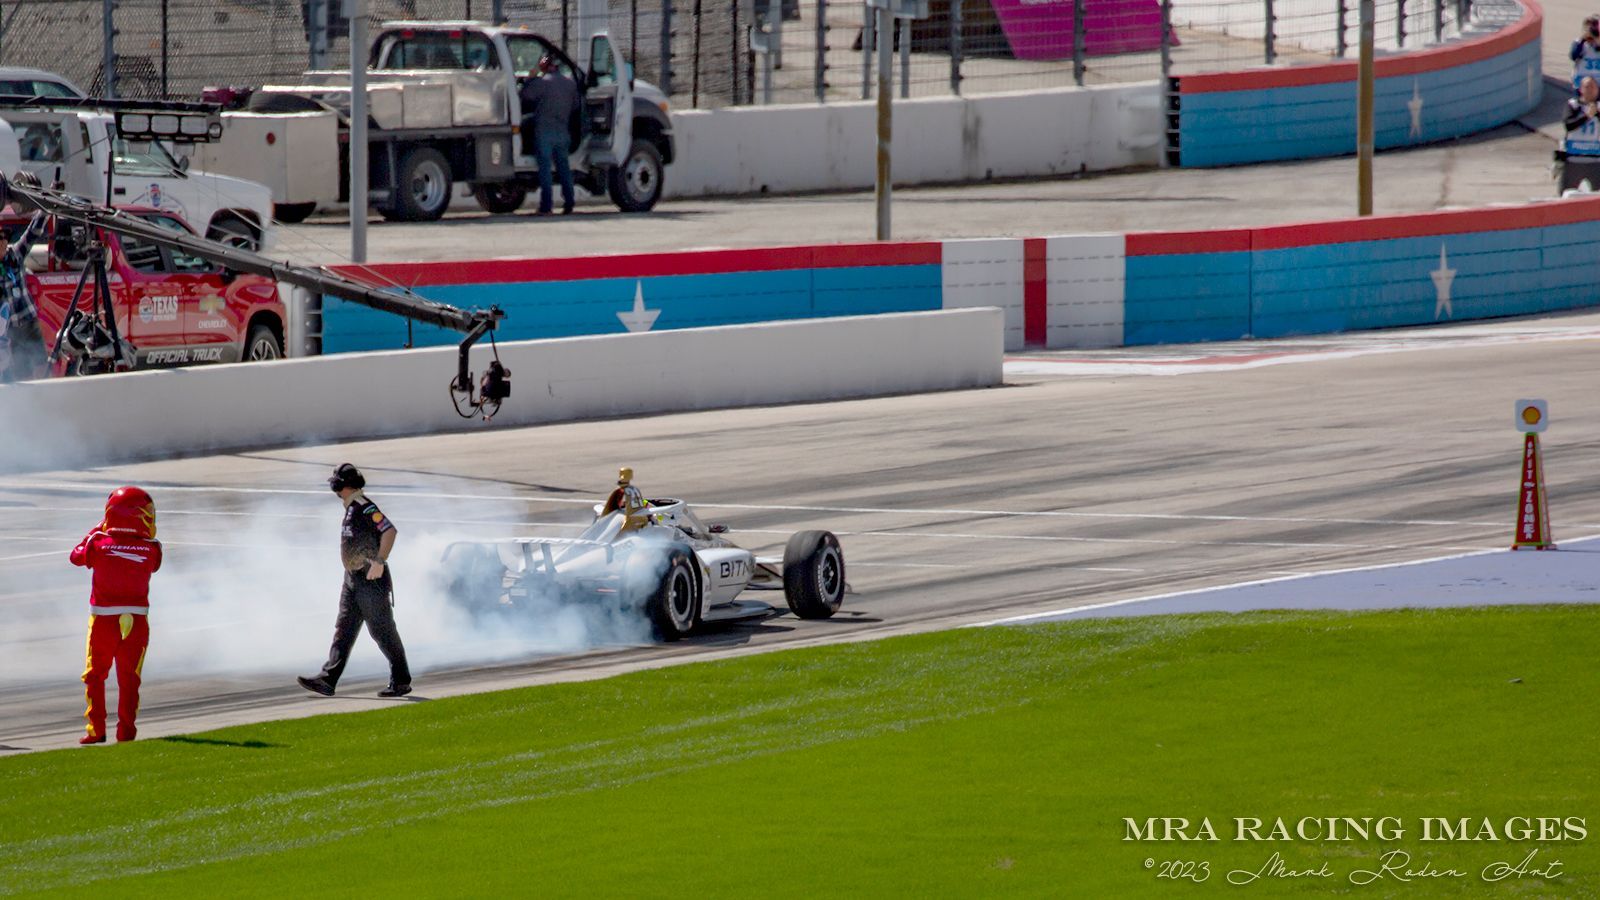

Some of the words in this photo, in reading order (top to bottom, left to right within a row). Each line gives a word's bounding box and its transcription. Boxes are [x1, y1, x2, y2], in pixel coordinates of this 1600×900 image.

[152, 296, 177, 313] TEXAS
[147, 350, 188, 363] OFFICIAL
[193, 348, 223, 361] TRUCK
